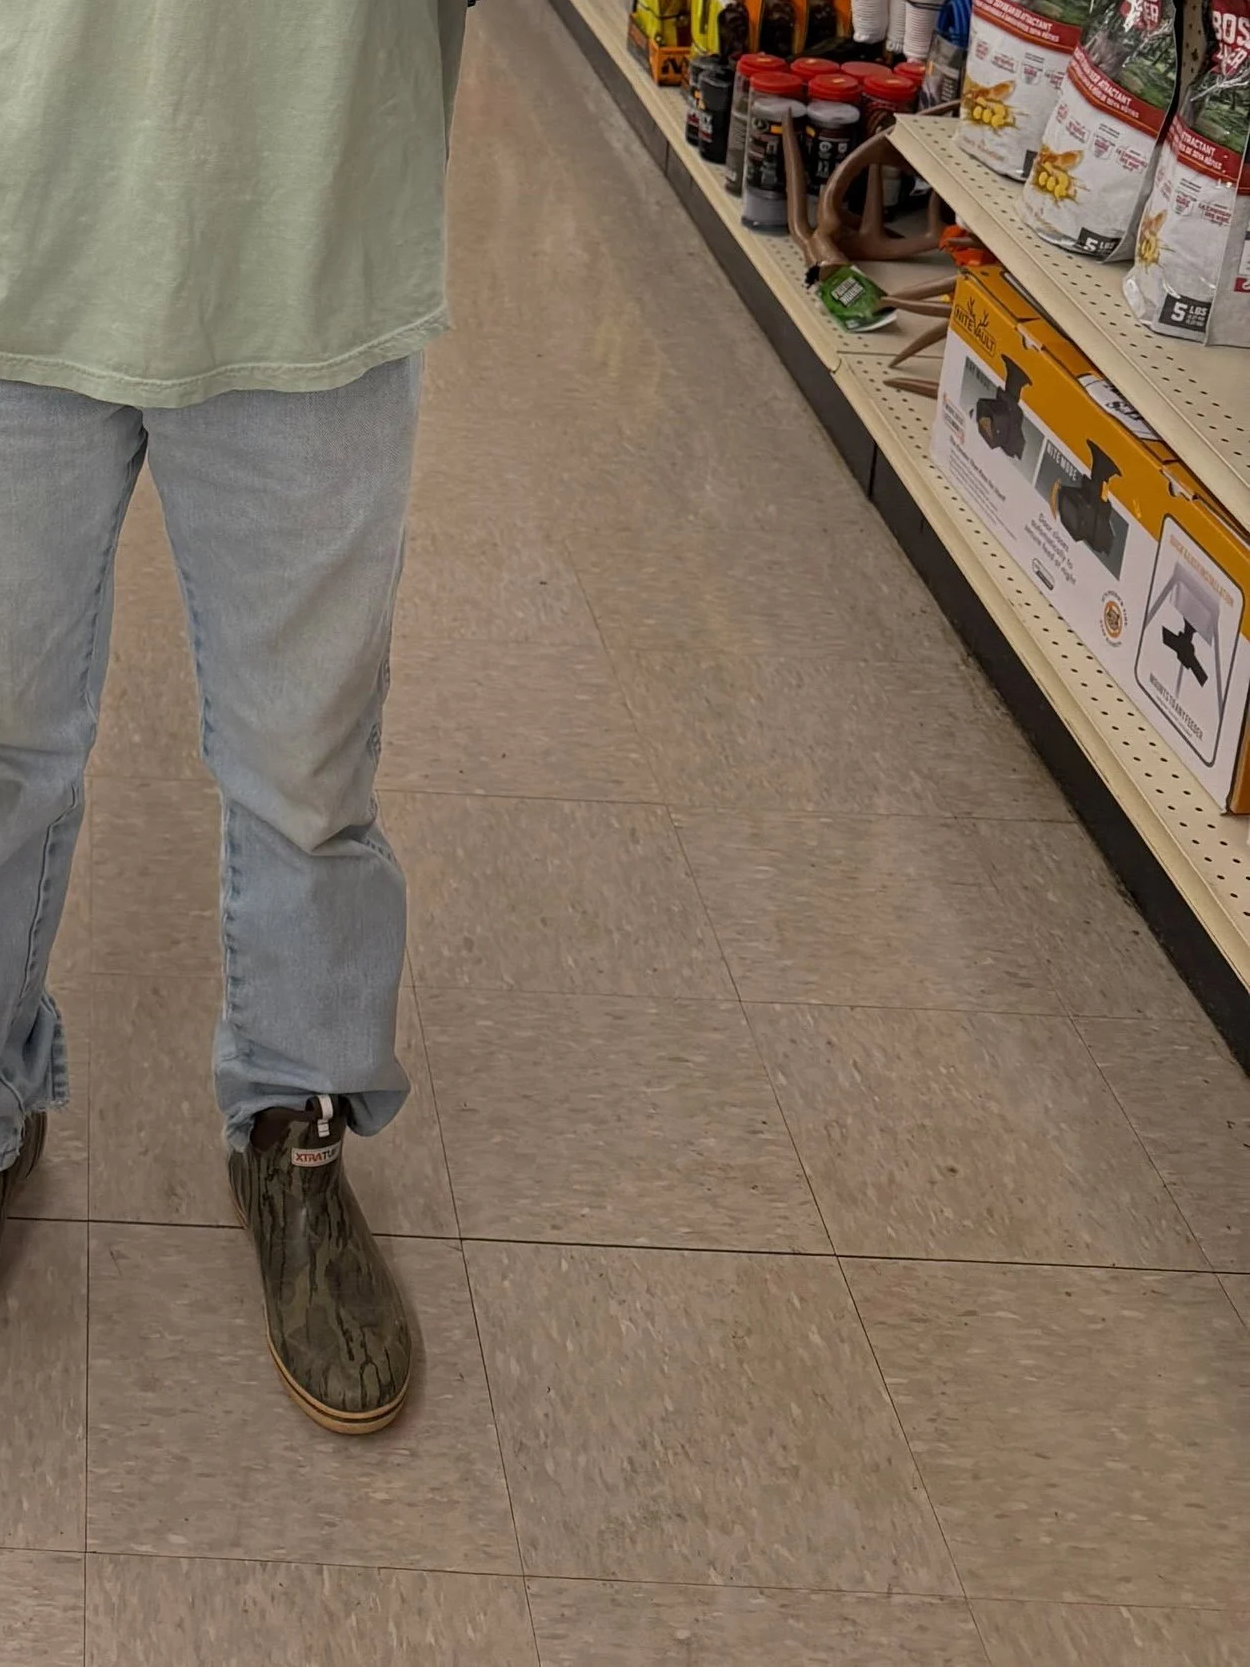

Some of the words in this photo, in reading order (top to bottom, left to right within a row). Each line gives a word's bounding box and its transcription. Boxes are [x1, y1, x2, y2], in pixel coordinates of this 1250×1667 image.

[1084, 236, 1098, 253] 5
[1172, 302, 1188, 322] 5
[955, 306, 975, 332] NITE
[974, 320, 996, 352] VAULT
